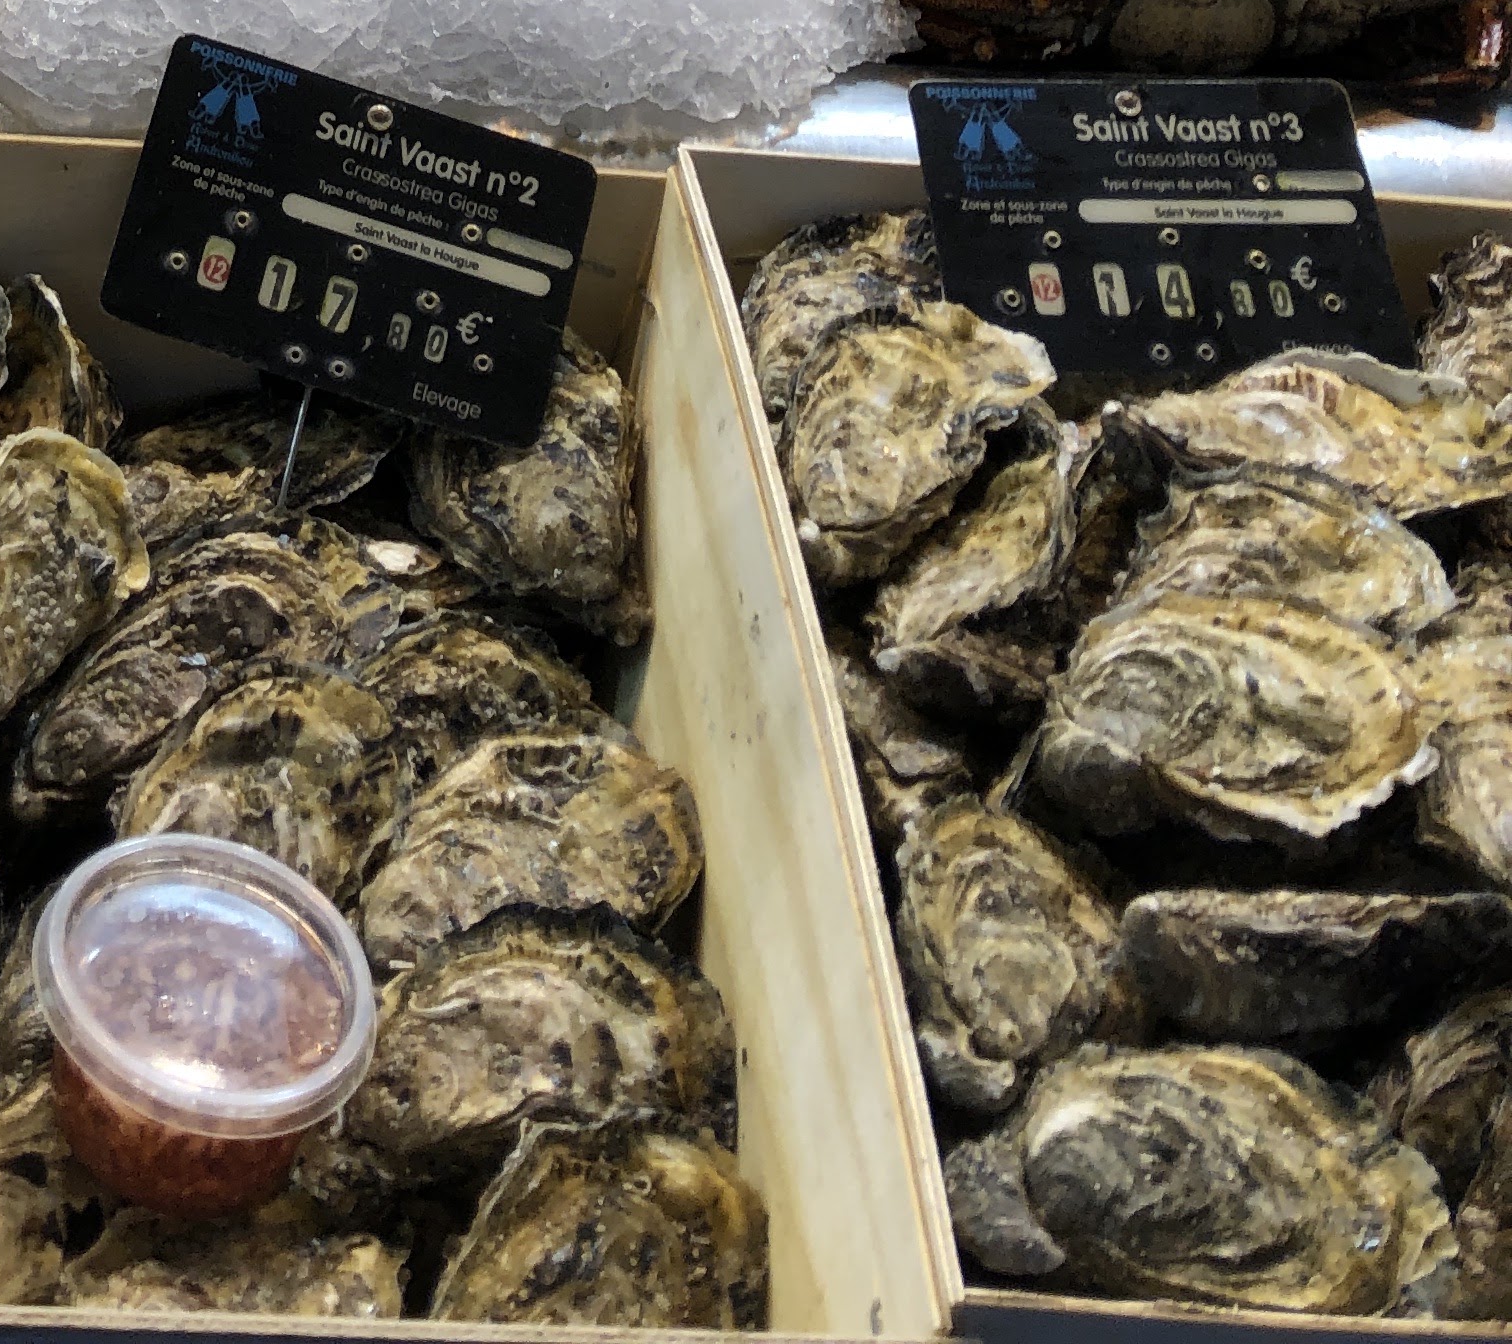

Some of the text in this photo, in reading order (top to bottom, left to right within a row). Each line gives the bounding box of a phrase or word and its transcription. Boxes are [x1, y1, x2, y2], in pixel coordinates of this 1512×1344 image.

[190, 41, 298, 87] POISSONNERIE
[925, 86, 1037, 100] POISSONNERIE
[1073, 112, 1304, 143] Saint Vaast n°3
[315, 111, 392, 159] Saint
[400, 136, 482, 187] Vaast
[486, 171, 539, 207] n°2
[1115, 149, 1277, 171] Crassostrea Gigas
[171, 154, 275, 198] Zone et sous-zone
[194, 177, 246, 202] de pêche
[342, 158, 499, 222] Crassostrea Gigas
[1103, 176, 1129, 191] Type
[1177, 179, 1193, 190] de
[319, 179, 343, 197] Type
[346, 188, 388, 212] d'engin
[391, 204, 405, 217] de
[960, 198, 990, 211] Zone
[993, 199, 1006, 211] et
[990, 213, 1005, 224] de
[1154, 207, 1184, 219] Saint
[355, 221, 480, 271] Saint Vaast la Hougue
[204, 255, 230, 282] 12
[413, 382, 483, 420] Elevage
